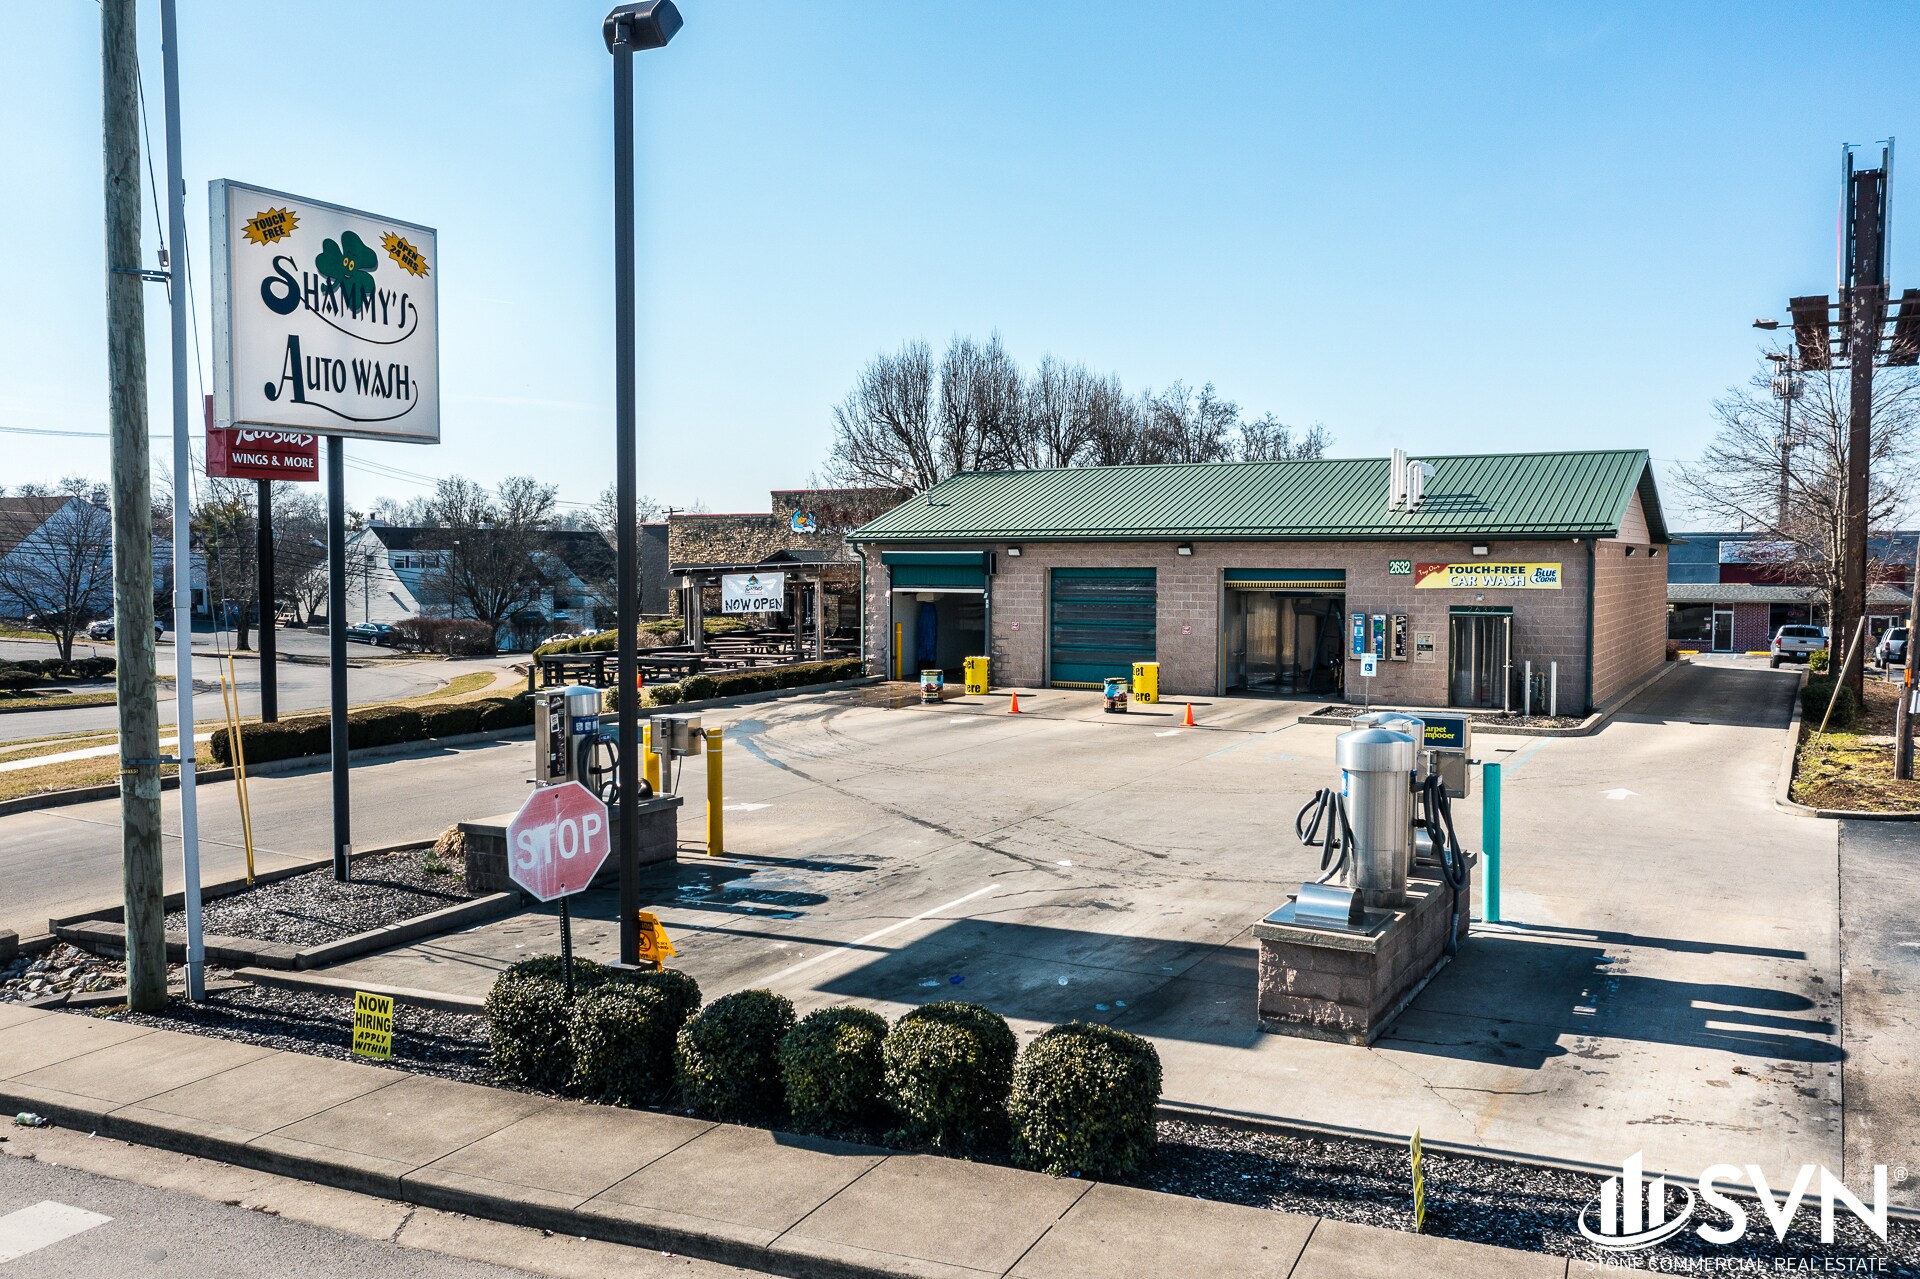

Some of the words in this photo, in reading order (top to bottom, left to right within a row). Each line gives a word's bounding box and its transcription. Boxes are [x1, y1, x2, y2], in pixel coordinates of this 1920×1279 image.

[253, 213, 286, 231] TOUCH
[262, 225, 285, 240] FREE
[390, 245, 401, 257] 24
[402, 254, 418, 271] HRS
[397, 240, 418, 261] OPEN
[260, 255, 409, 329] SHAMMY'S
[264, 334, 347, 402] AUTO
[351, 357, 410, 401] WASH
[231, 452, 269, 466] WINGS
[271, 455, 280, 466] &
[283, 456, 314, 468] MORE
[1389, 561, 1411, 575] 2632
[1448, 565, 1526, 575] TOUCH-FREE
[1534, 567, 1557, 577] BLUE
[1448, 575, 1478, 587] CAR
[1481, 575, 1526, 587] WASH
[725, 598, 751, 611] NOW
[753, 597, 783, 610] OPEN
[1424, 726, 1447, 734] arpet
[516, 813, 601, 870] STOP
[358, 995, 389, 1014] NOW
[355, 1012, 391, 1033] HIRING
[358, 1031, 387, 1043] APPLY
[355, 1040, 388, 1055] WITHIN
